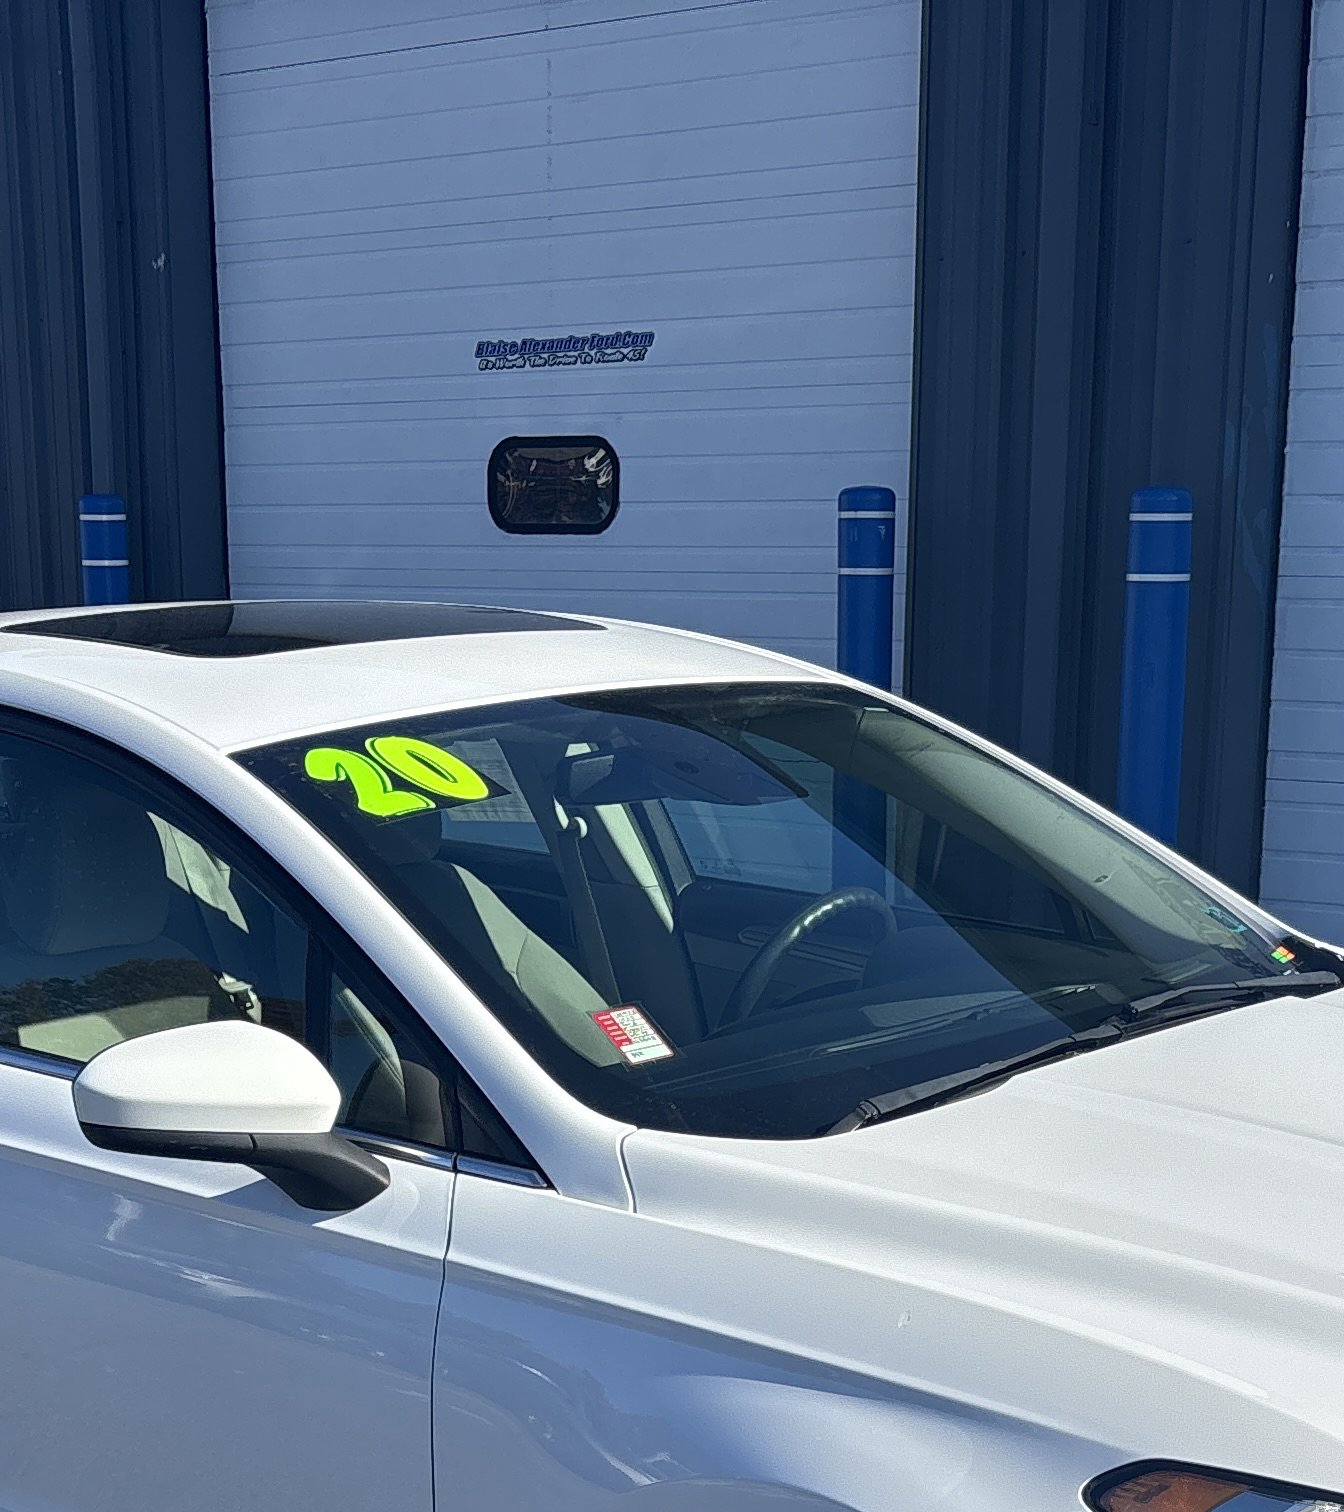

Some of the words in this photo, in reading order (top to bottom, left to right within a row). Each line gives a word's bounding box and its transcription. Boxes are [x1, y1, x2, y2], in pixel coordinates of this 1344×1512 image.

[527, 355, 548, 368] The
[578, 351, 593, 365] To
[304, 735, 490, 818] 20
